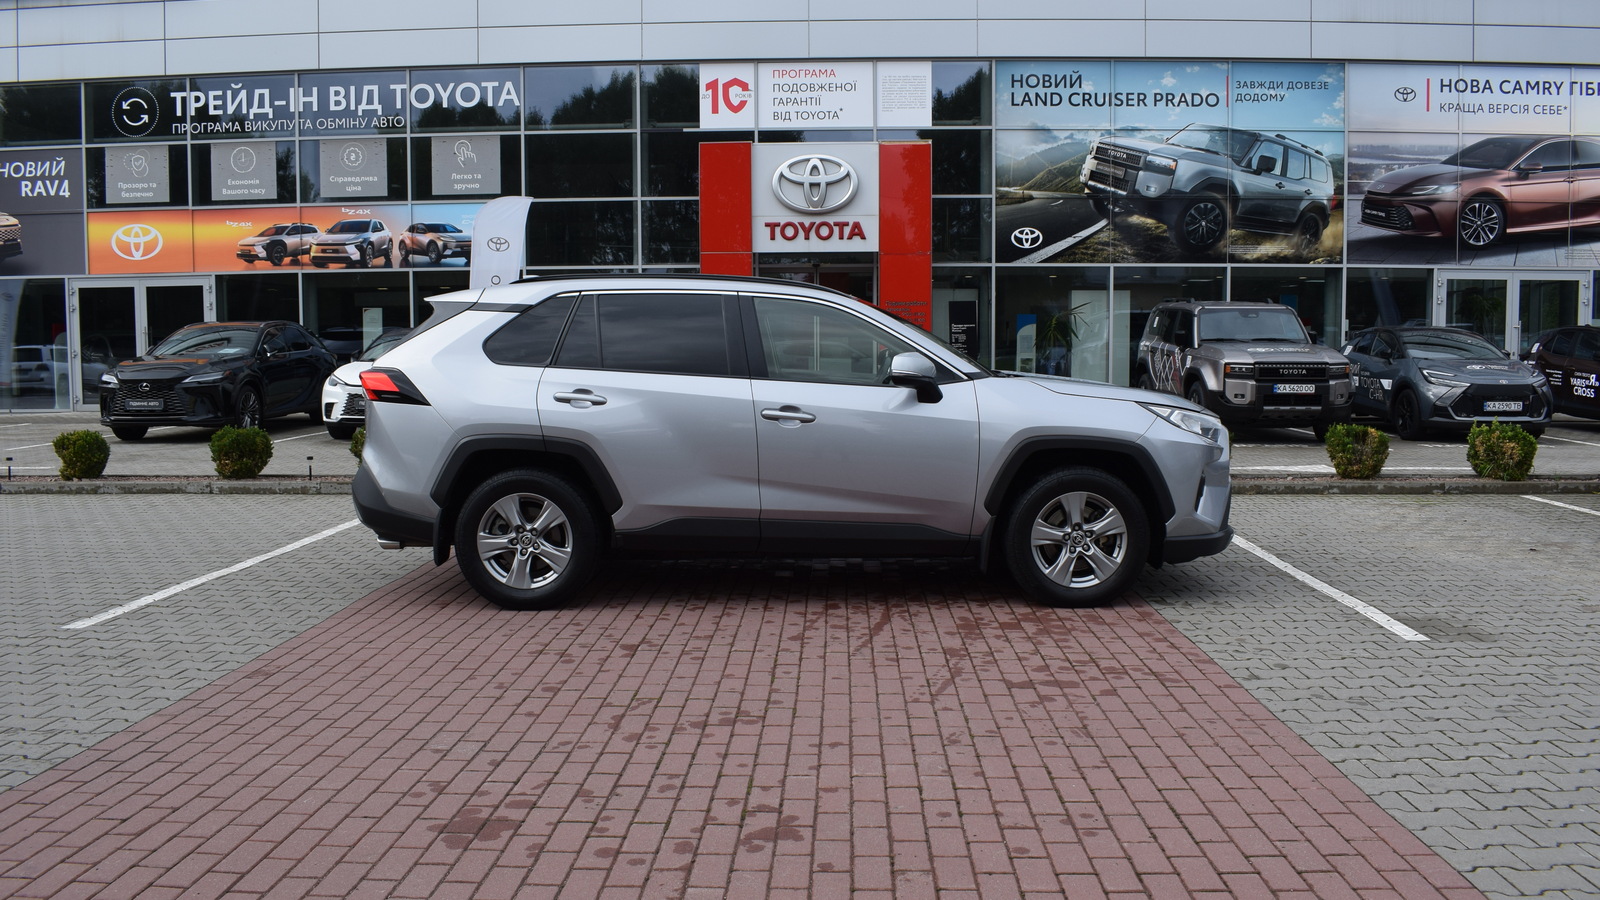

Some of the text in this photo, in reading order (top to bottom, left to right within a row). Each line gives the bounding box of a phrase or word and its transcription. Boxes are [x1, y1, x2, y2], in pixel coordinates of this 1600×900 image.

[772, 69, 837, 79] ПРОГРАМА
[1010, 70, 1083, 89] НОВИЙ
[772, 80, 858, 94] ПОДОВЖЕНОЇ
[1235, 80, 1329, 91] ЗАВЖДИ ДОВЕЗЕ
[1440, 78, 1494, 94] НОВА
[1499, 79, 1564, 96] CAMRY
[170, 81, 521, 120] ТРЕЙД-ІН ВІД TOYOTA
[772, 94, 822, 107] ГАРАНТІЇ
[1010, 92, 1220, 108] LAND CRUISER PRADO
[1235, 93, 1286, 103] ДОДОМУ
[1439, 102, 1485, 115] КРАЩА
[1488, 103, 1529, 115] ВЕРСІЯ
[773, 111, 792, 122] ВІД
[172, 116, 405, 134] ПРОГРАМА ВИКУПУ ТА ОБМІНУ АВТО
[1107, 149, 1127, 159] TOYOTA
[0, 157, 66, 178] НОВИЙ
[227, 177, 260, 186] Економія
[329, 175, 378, 183] Справедлива
[20, 179, 71, 198] RAV4
[118, 182, 148, 190] Прозоро
[345, 184, 362, 192] ціна
[453, 182, 480, 190] зручно
[250, 188, 266, 196] часу
[764, 220, 867, 241] TOYOTA
[1570, 377, 1586, 387] YARIS
[1573, 386, 1595, 398] CROSS
